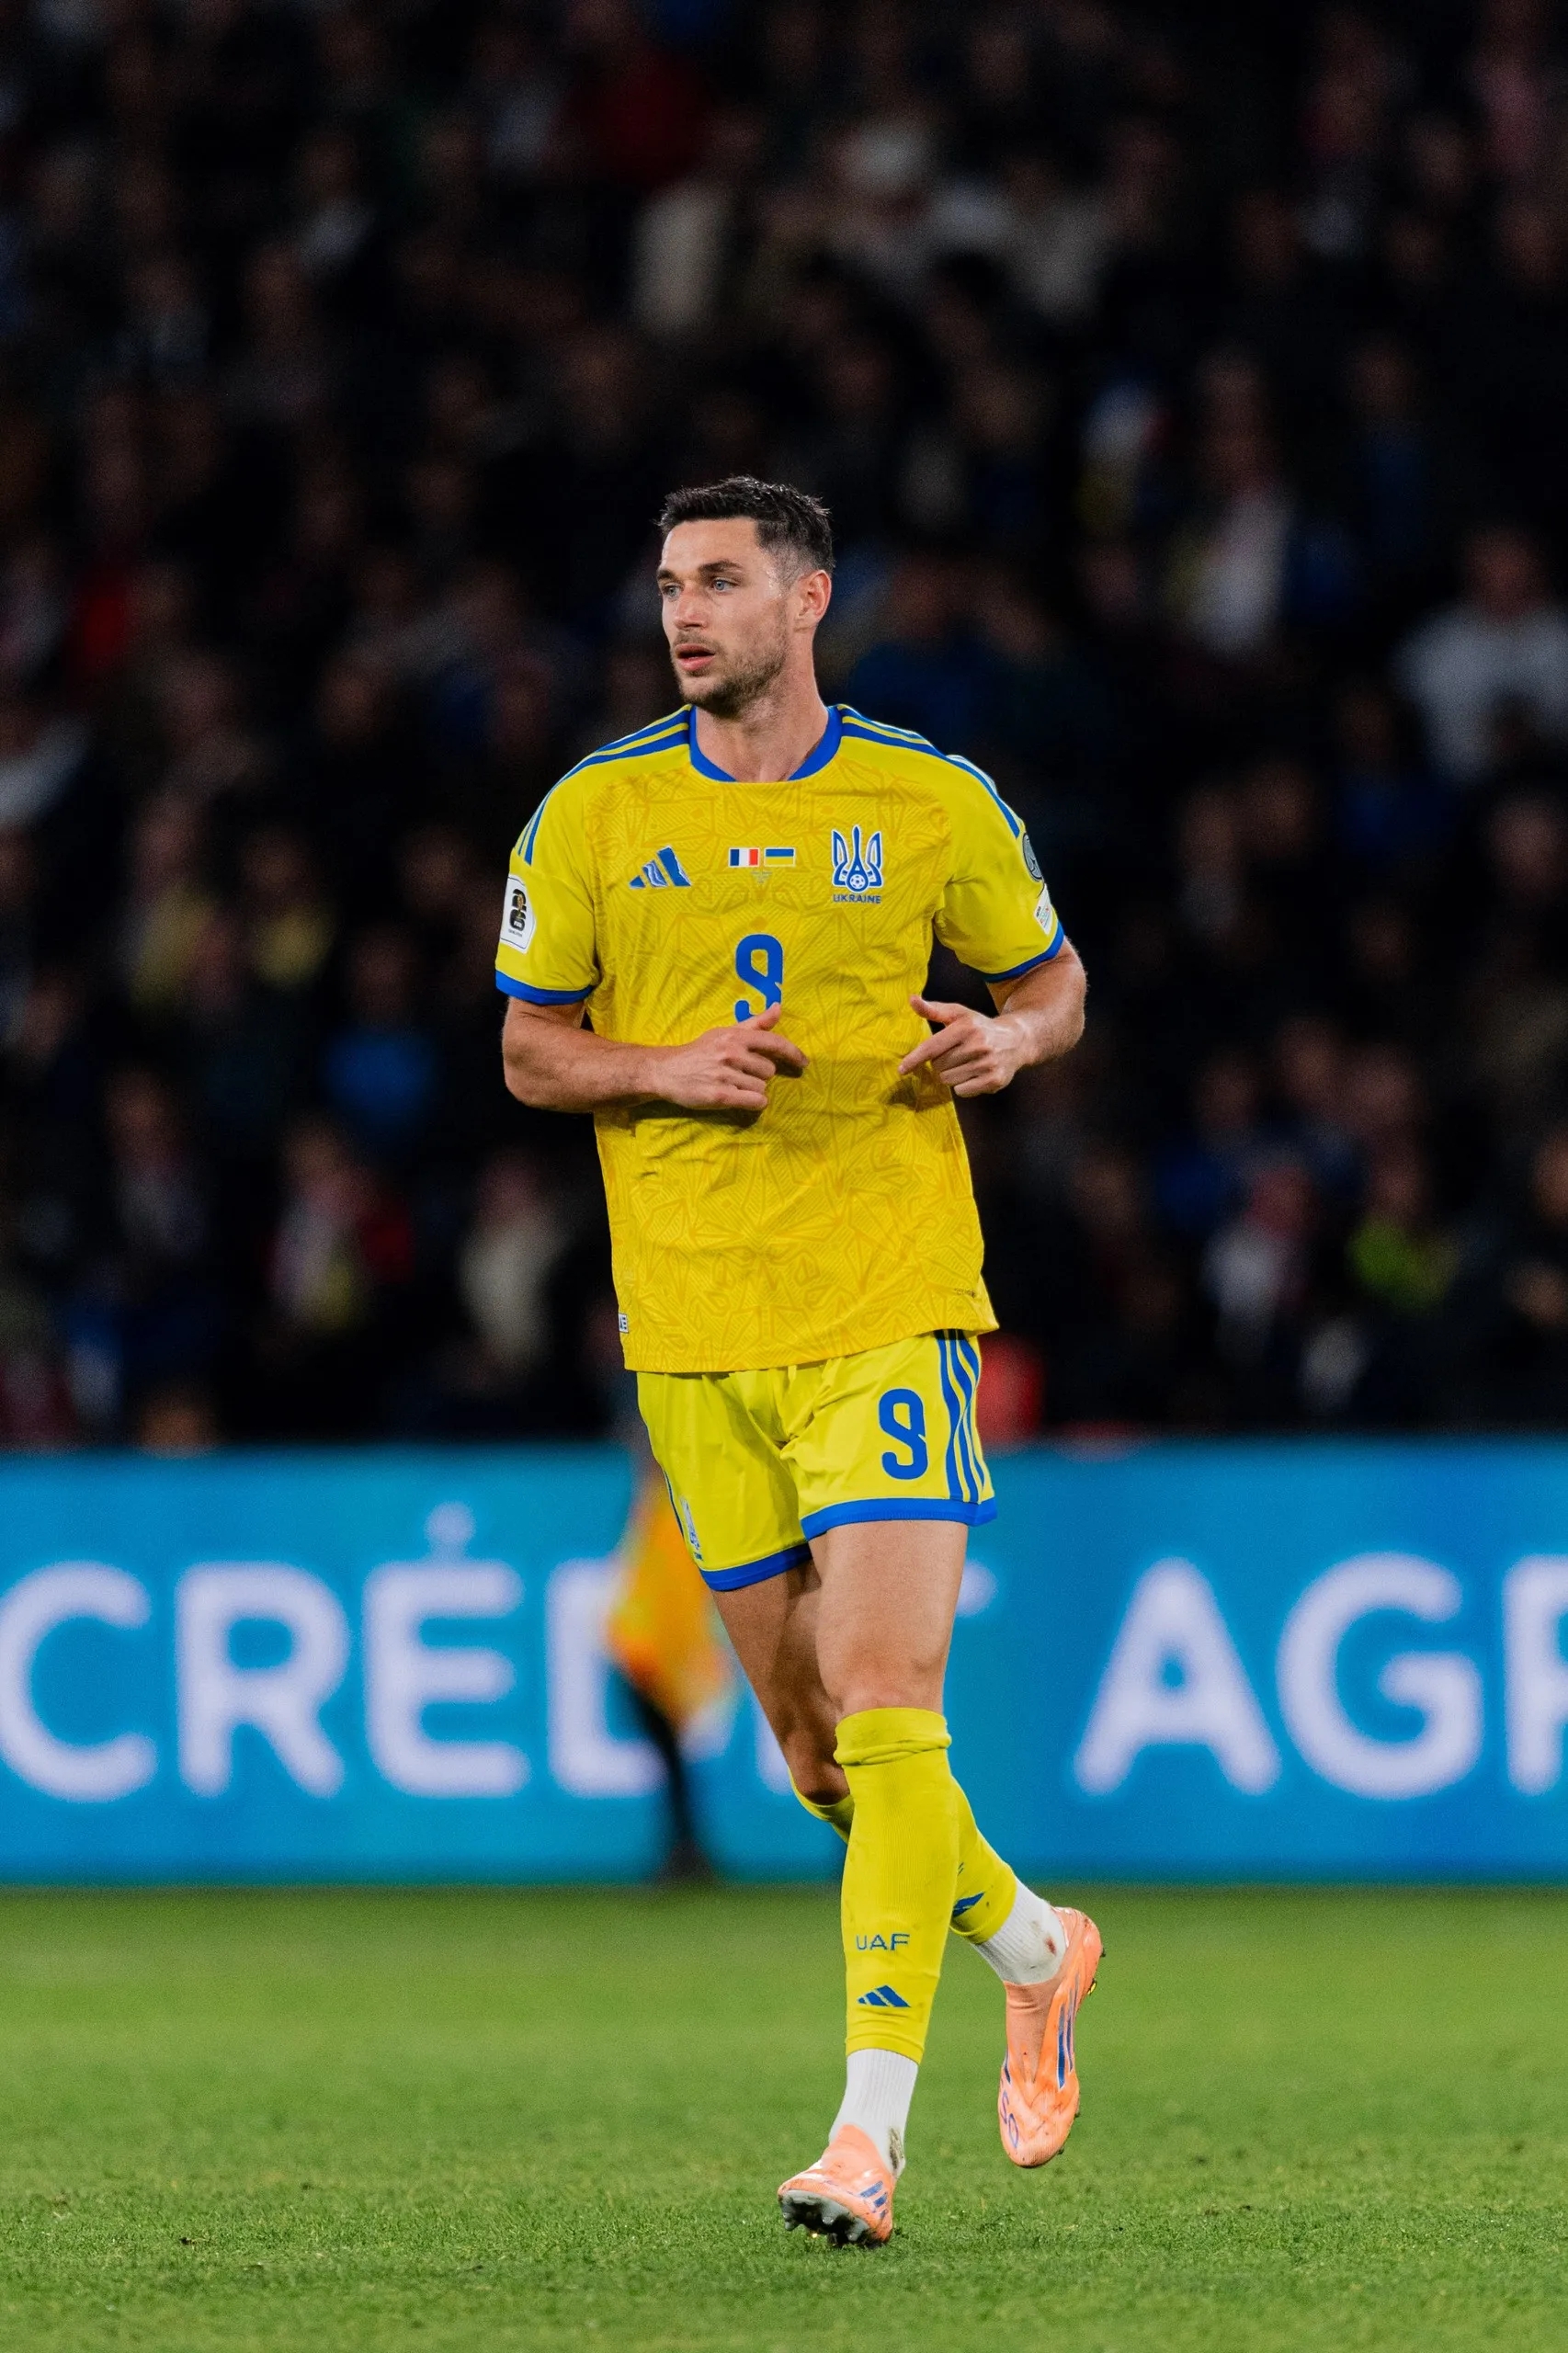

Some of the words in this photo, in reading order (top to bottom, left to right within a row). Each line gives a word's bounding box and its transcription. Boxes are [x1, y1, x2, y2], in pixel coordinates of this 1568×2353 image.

[833, 893, 881, 904] UKRAINE
[734, 933, 783, 1023] 9
[878, 1388, 928, 1480] 9
[856, 1933, 910, 1951] UAF
